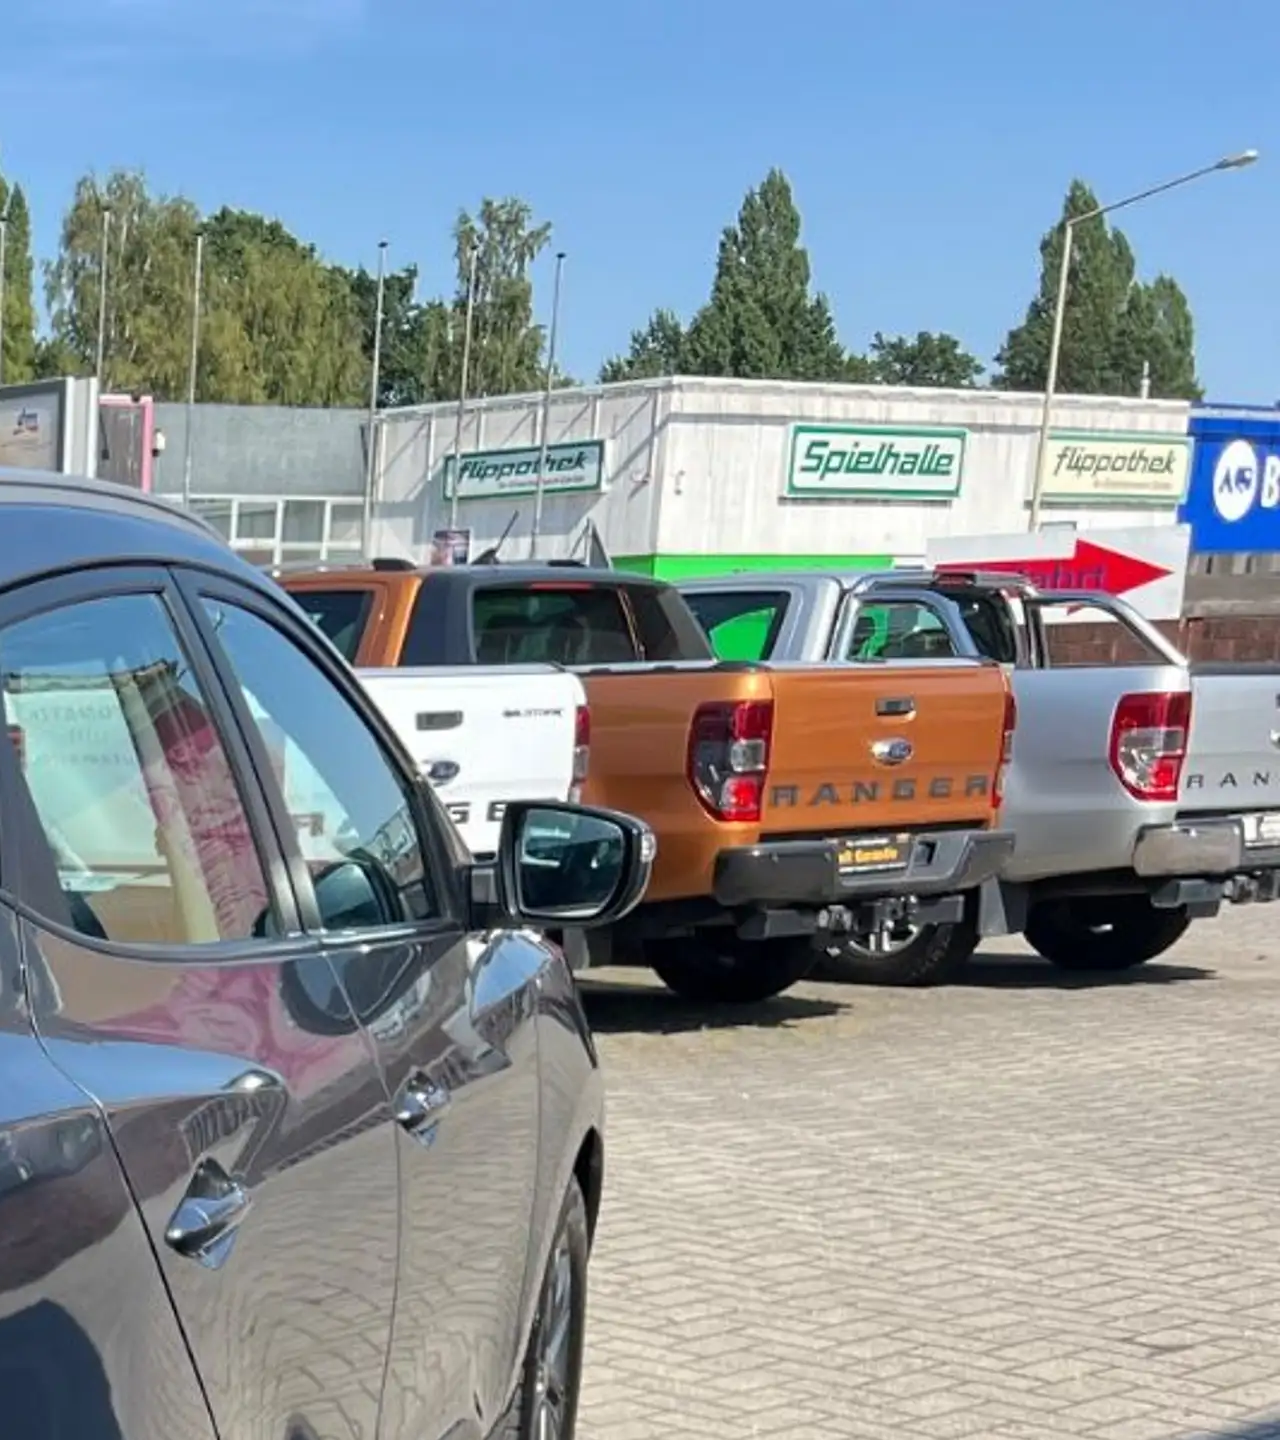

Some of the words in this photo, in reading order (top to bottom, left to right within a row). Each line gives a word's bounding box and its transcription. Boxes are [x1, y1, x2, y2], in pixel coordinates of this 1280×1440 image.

[800, 440, 955, 481] Spielhalle
[1053, 446, 1177, 477] flippothek
[771, 773, 990, 808] RANGER
